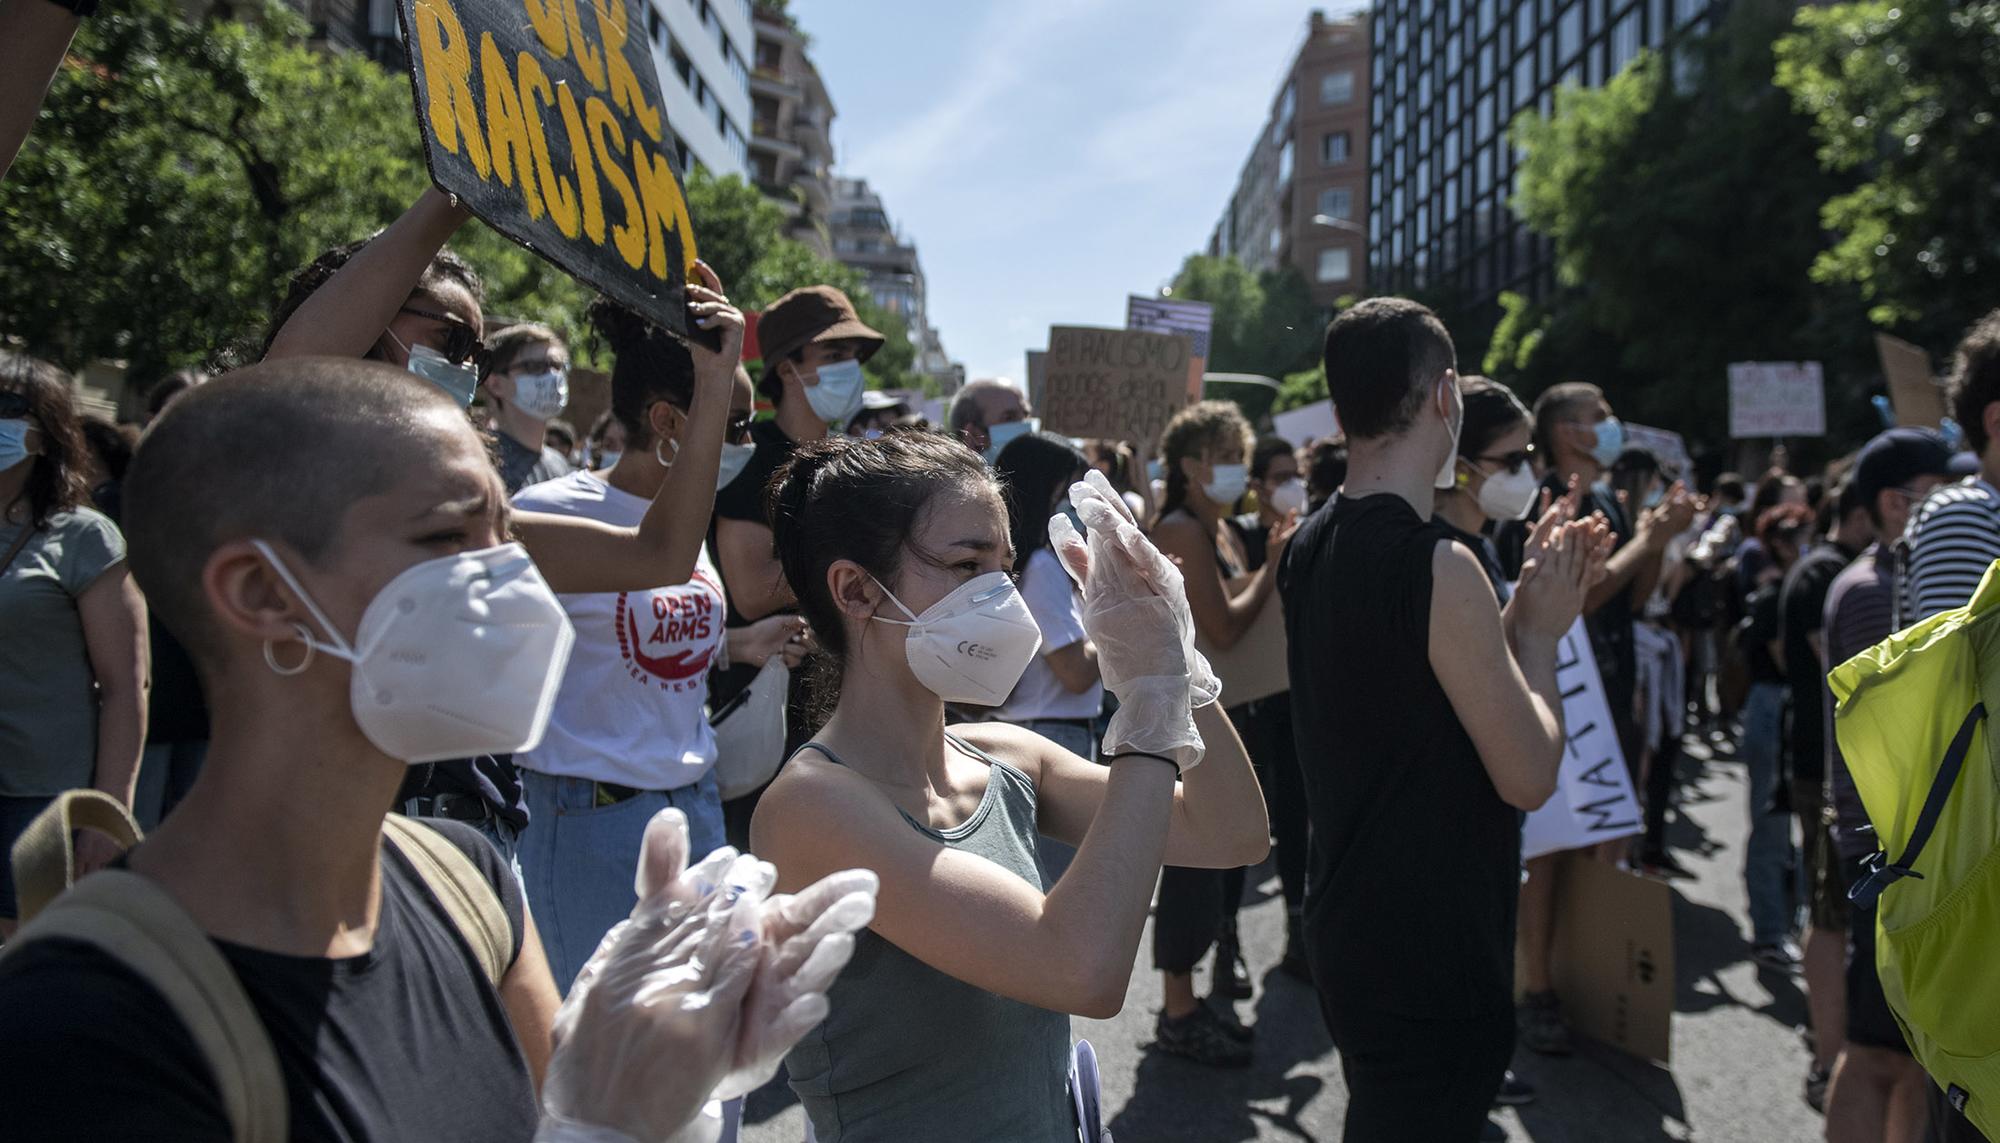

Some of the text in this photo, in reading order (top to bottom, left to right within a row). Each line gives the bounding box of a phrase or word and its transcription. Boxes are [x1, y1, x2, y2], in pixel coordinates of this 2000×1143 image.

[415, 0, 697, 280] RACISM
[1080, 333, 1185, 371] RACISMO
[652, 593, 712, 620] OPEN
[648, 616, 711, 644] ARMS
[957, 640, 979, 657] CE
